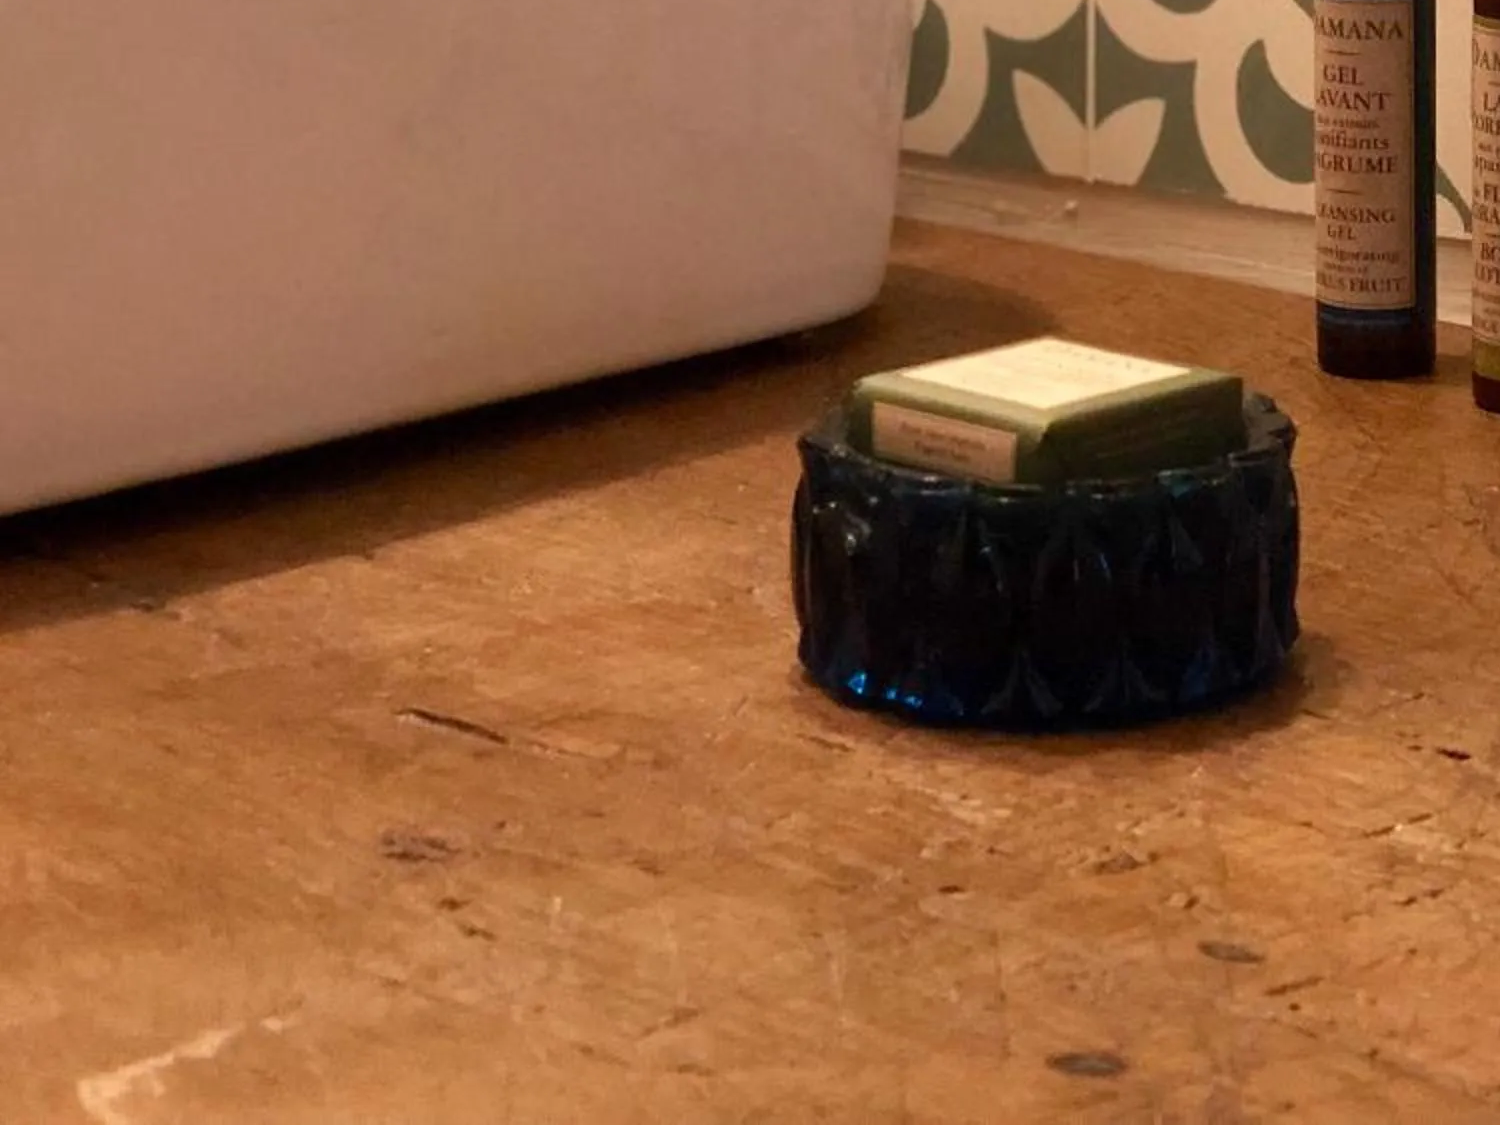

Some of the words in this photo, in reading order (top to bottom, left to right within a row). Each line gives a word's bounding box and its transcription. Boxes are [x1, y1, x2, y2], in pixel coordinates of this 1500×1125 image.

[1315, 15, 1405, 41] AMANA
[1322, 64, 1365, 87] GEL
[1315, 88, 1394, 111] AVANT
[1316, 152, 1399, 174] GRUME
